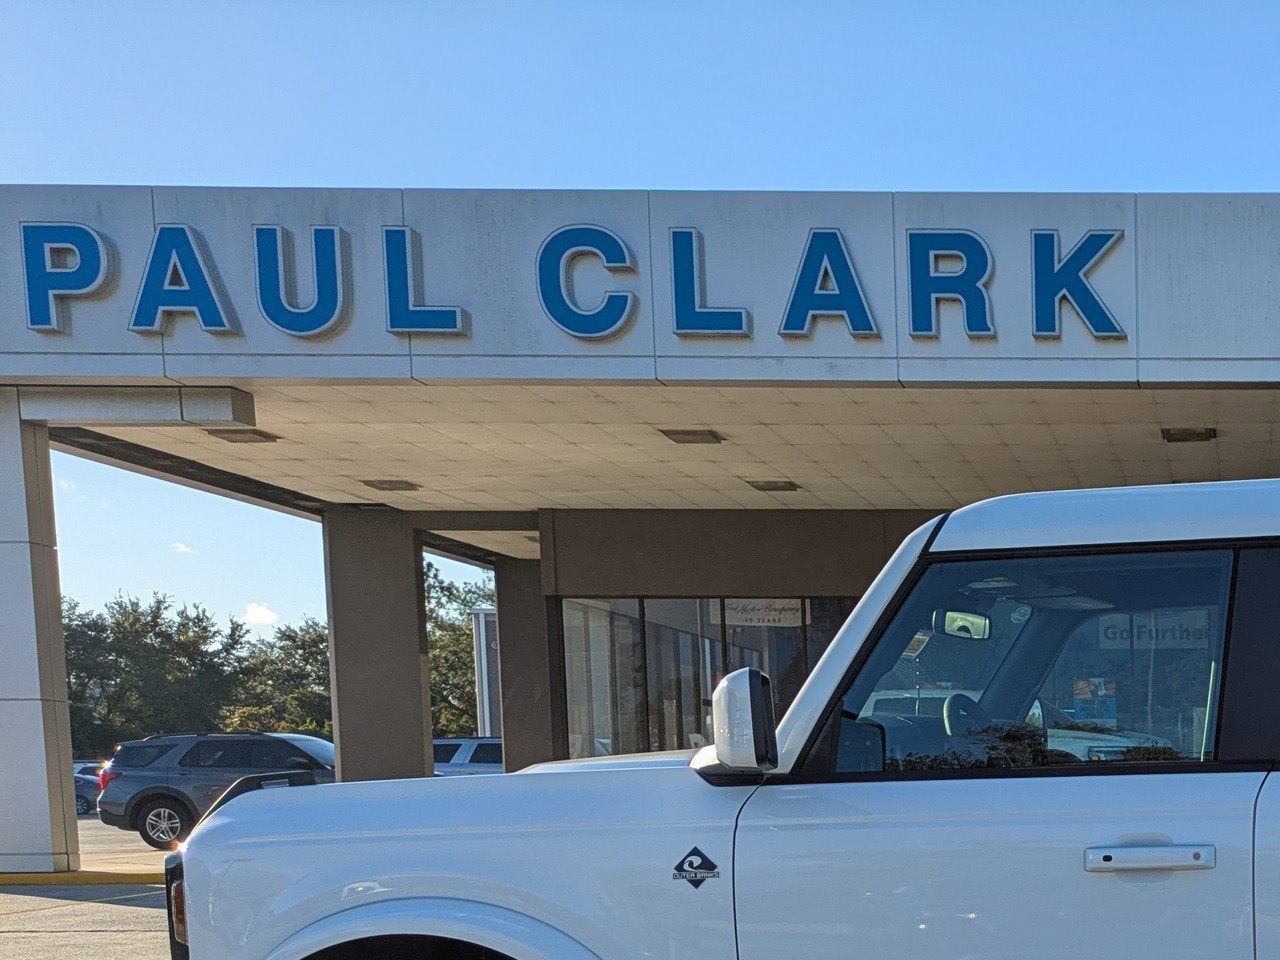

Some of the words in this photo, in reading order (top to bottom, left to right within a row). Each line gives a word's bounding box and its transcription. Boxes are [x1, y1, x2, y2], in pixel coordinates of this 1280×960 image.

[19, 221, 464, 336] PAUL
[536, 223, 1127, 338] CLARK
[1103, 624, 1130, 641] Go
[697, 871, 719, 879] BANKS
